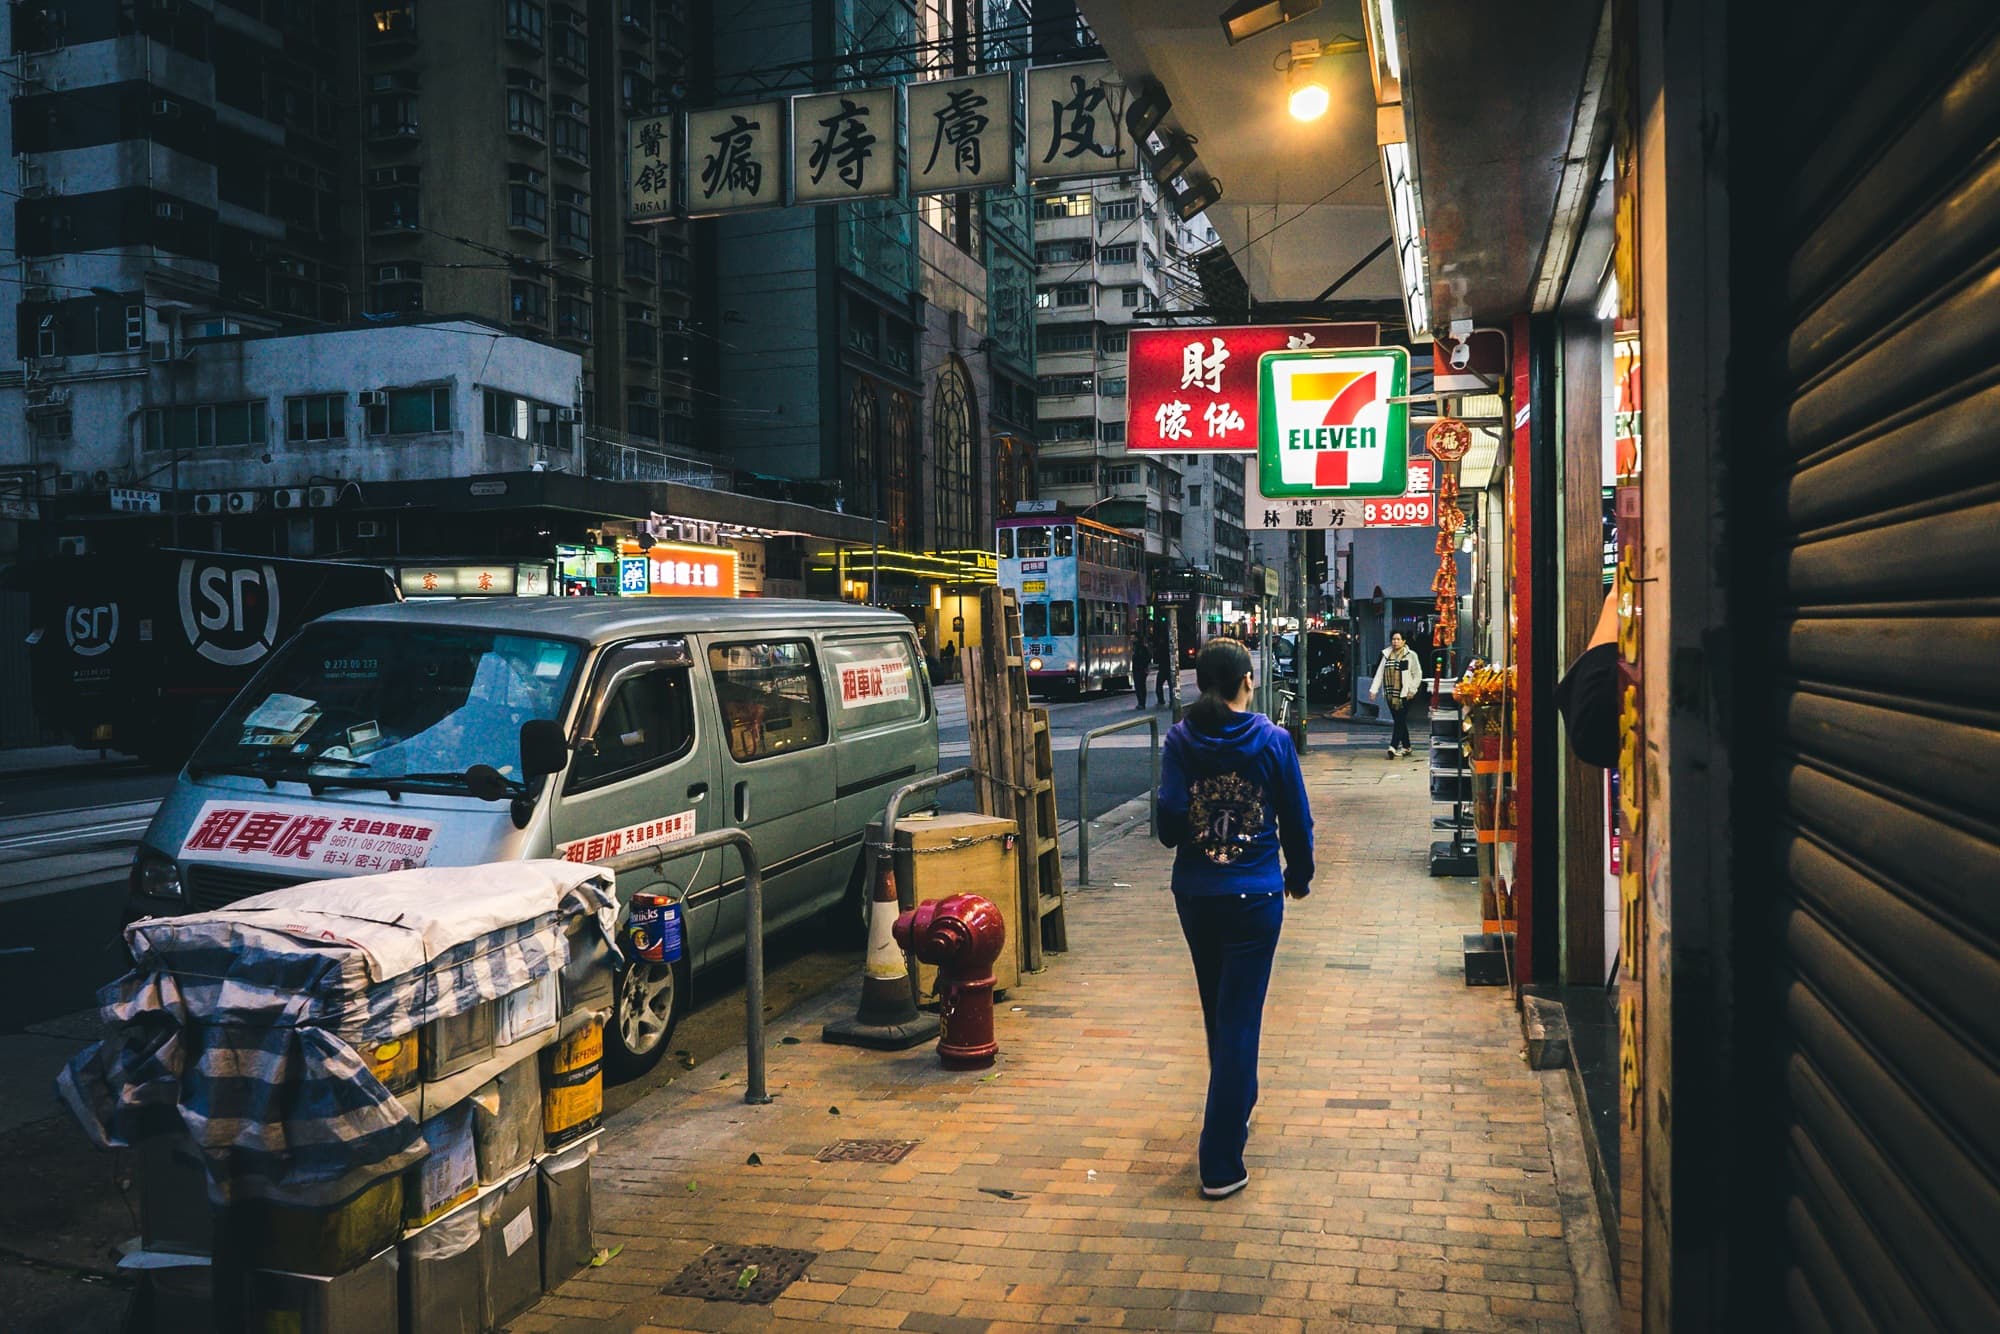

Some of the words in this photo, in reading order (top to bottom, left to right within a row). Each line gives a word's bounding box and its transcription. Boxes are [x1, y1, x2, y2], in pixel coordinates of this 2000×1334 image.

[634, 120, 668, 195] 醫館
[1291, 370, 1377, 486] 7
[1027, 500, 1045, 511] 75
[1381, 504, 1429, 520] 3099
[842, 667, 883, 701] 租車快
[184, 808, 337, 860] 租車快
[338, 817, 433, 841] 天皇自駕租車
[626, 817, 682, 845] 天皇自駕租車
